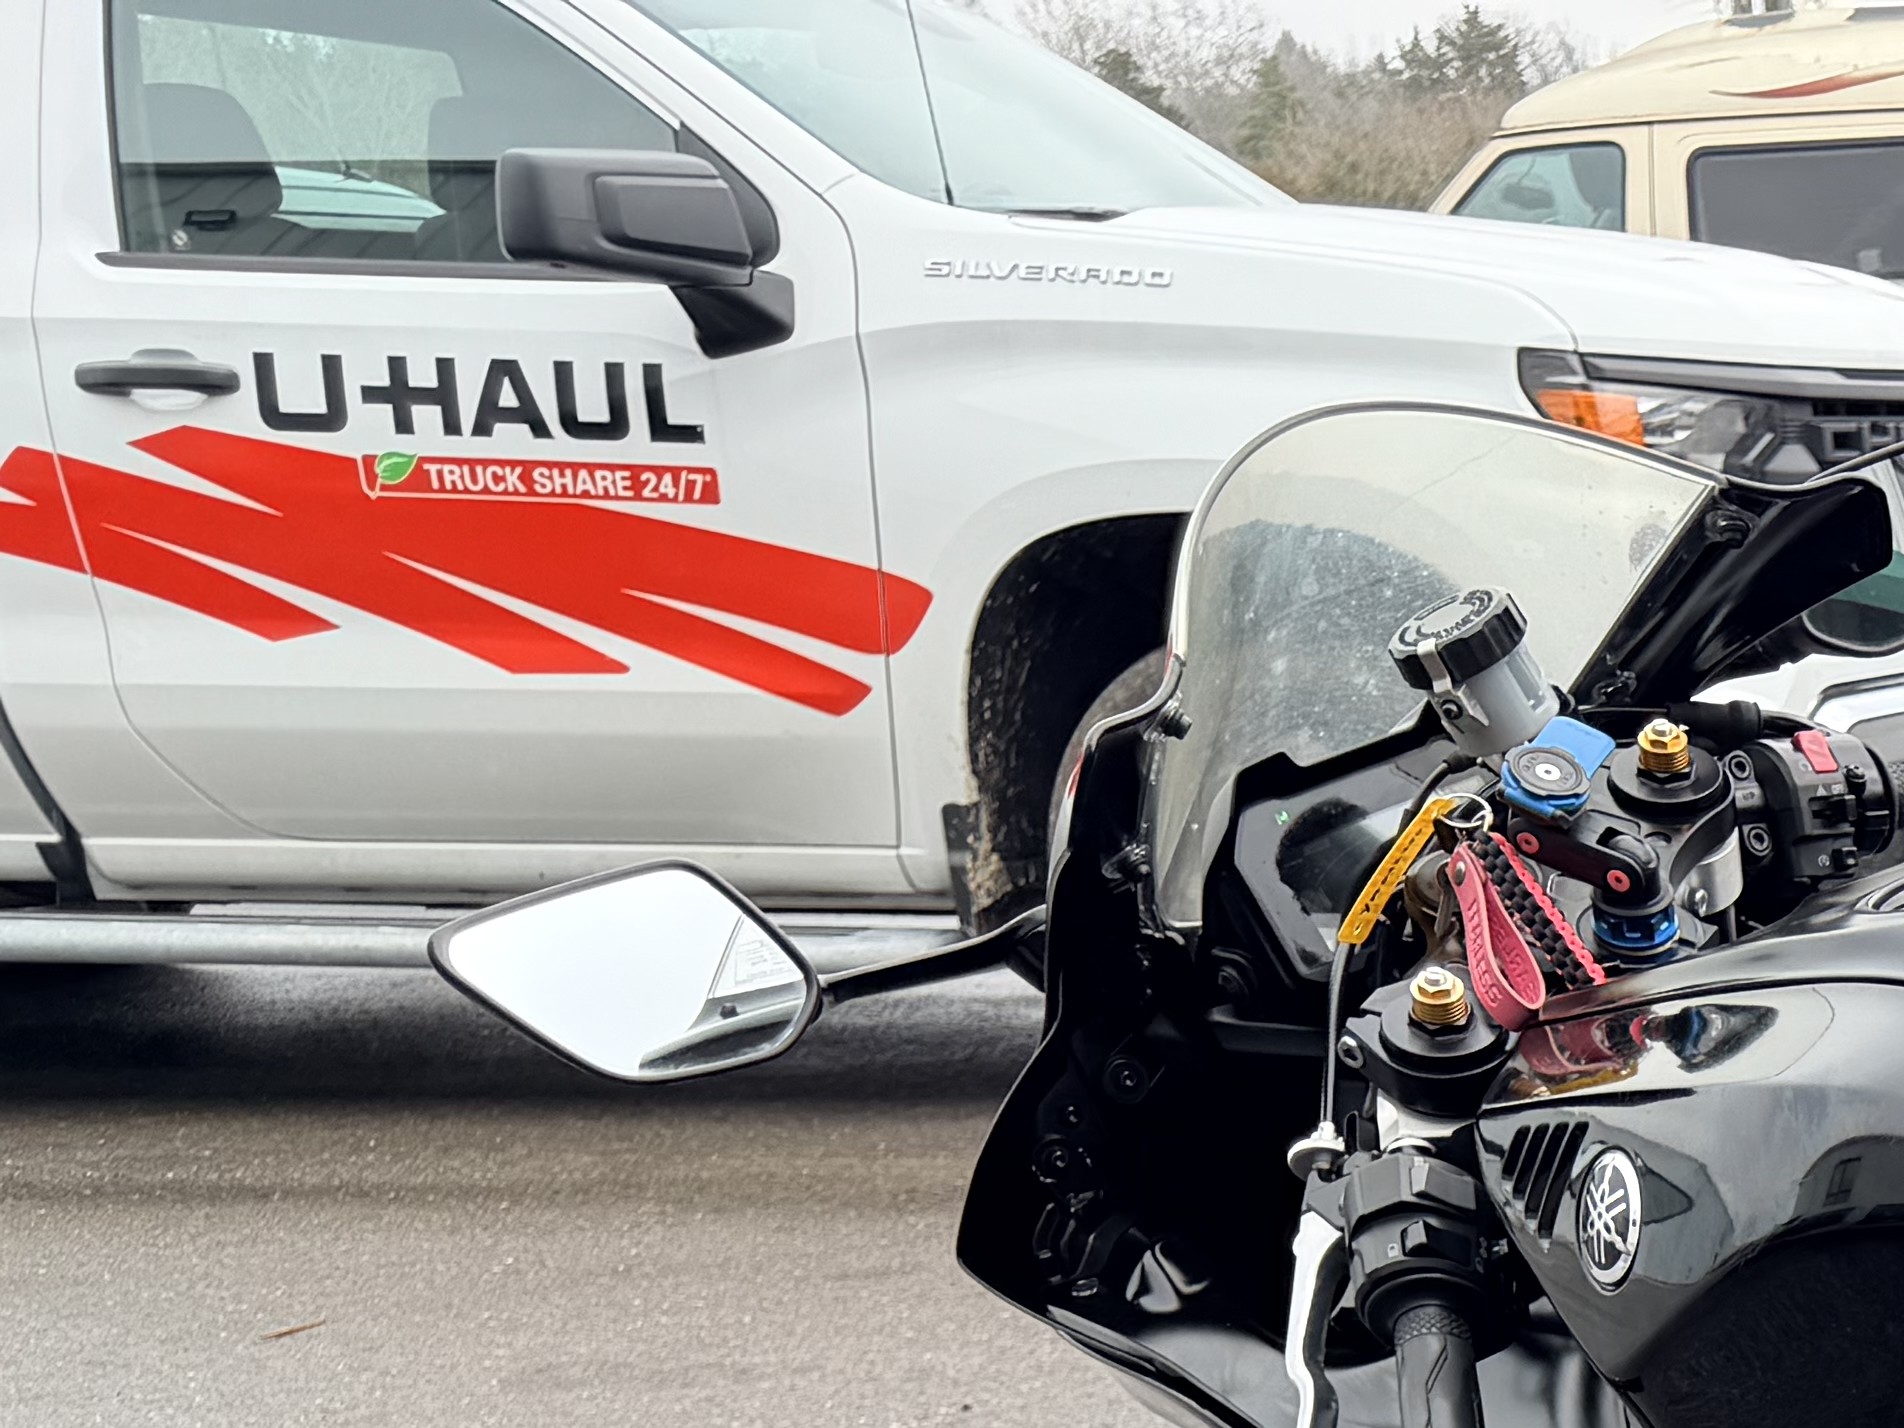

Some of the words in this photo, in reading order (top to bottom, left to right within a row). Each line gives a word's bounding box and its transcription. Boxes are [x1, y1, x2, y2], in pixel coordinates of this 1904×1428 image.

[924, 258, 1174, 288] SILVERADO
[253, 352, 706, 445] U-HAUL
[423, 463, 522, 494] TRUCK
[532, 469, 634, 498] SHARE
